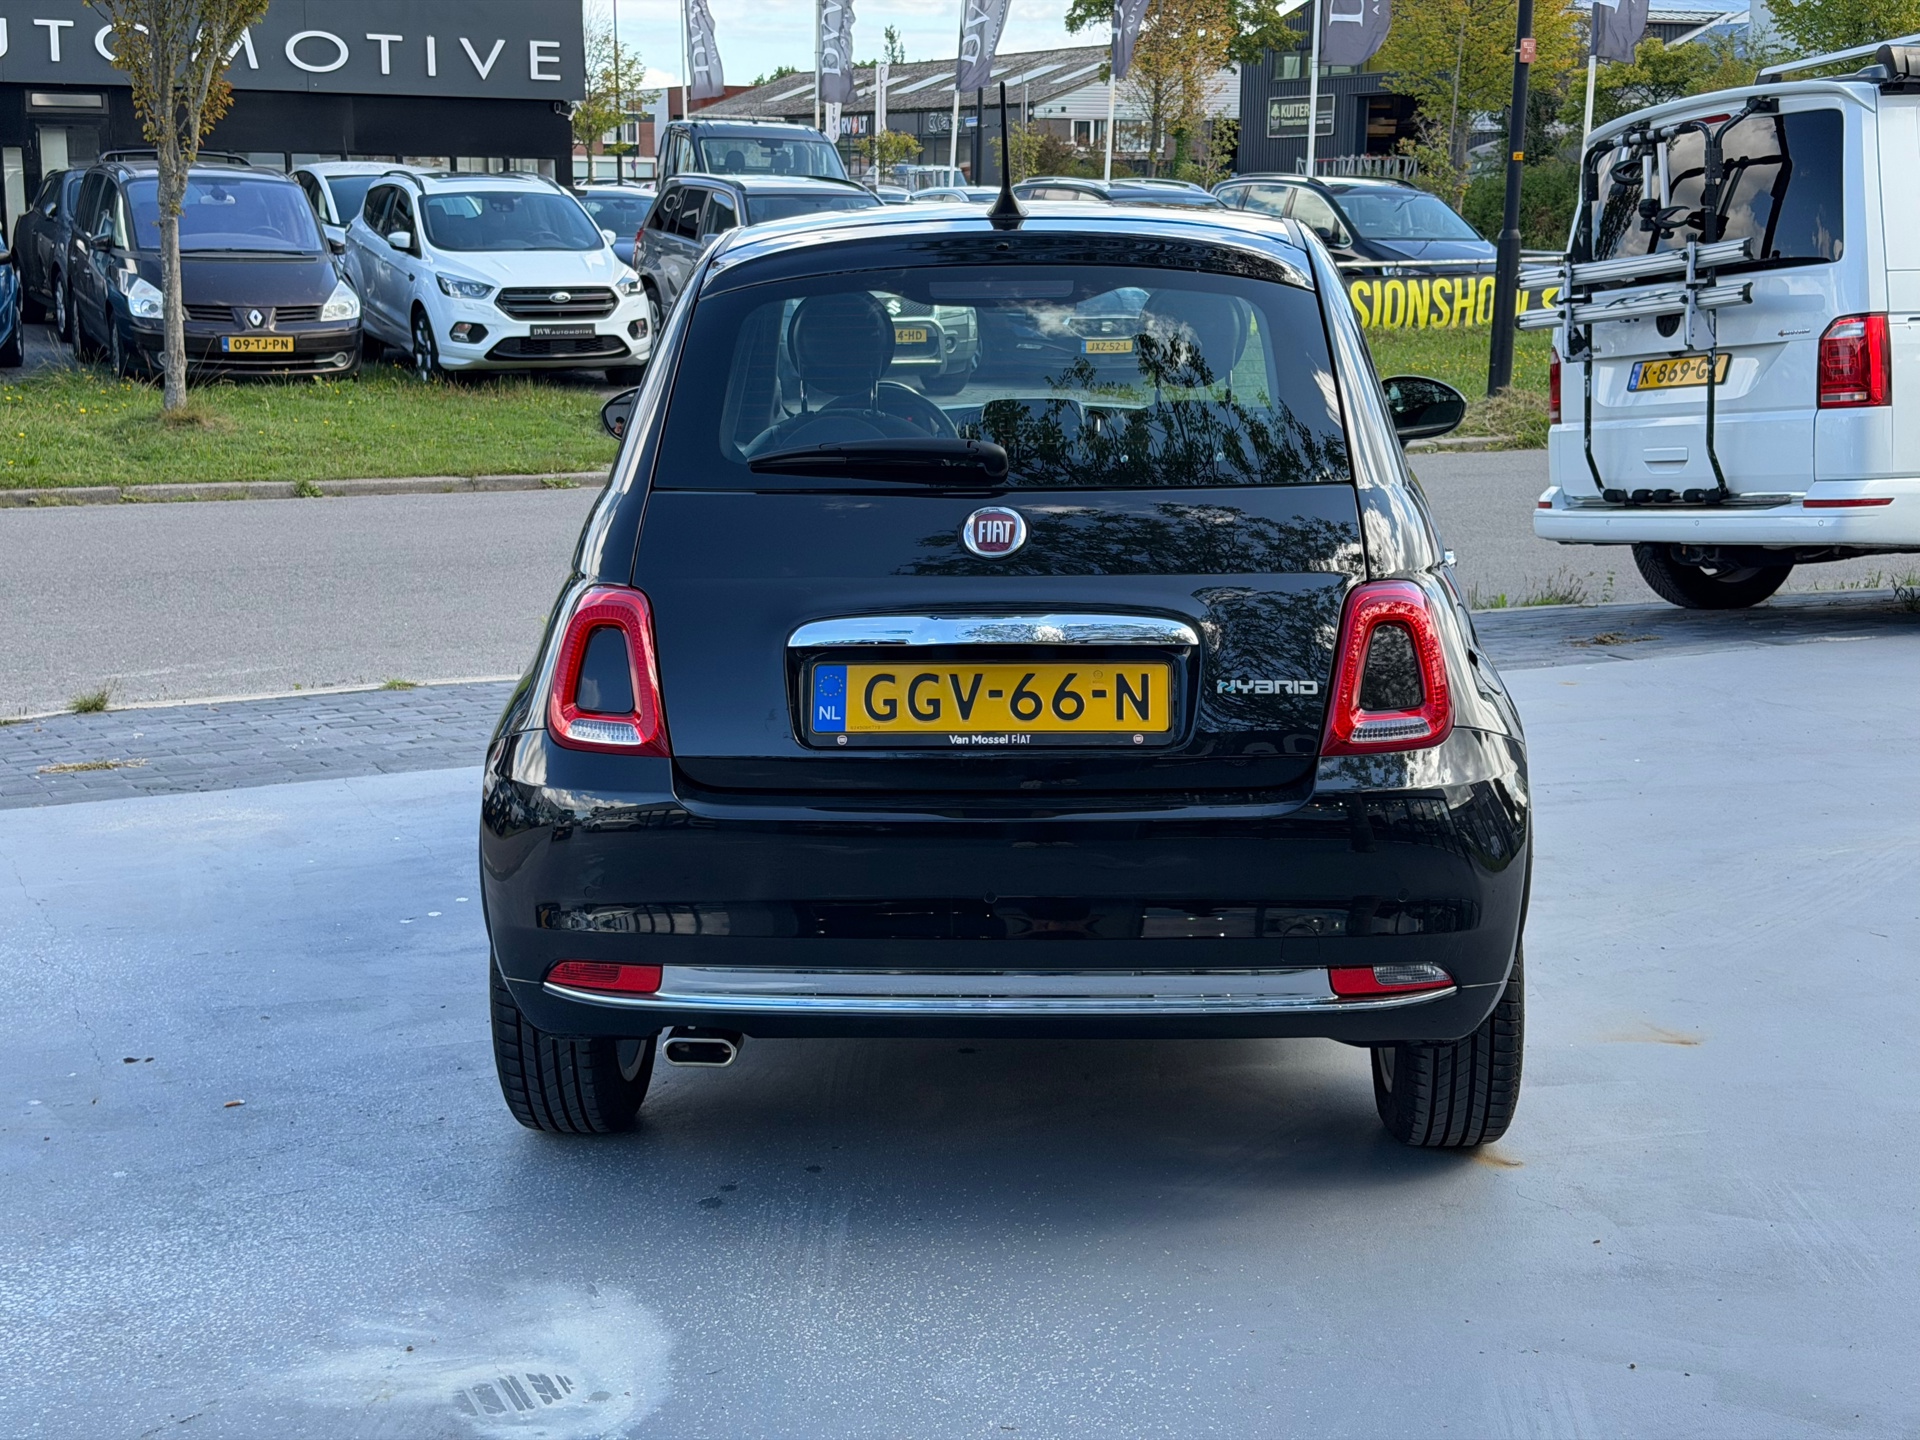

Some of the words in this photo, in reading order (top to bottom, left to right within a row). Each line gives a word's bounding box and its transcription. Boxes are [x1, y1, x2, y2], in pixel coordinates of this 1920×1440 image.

[233, 338, 289, 350] 09-TJ-PN
[1090, 341, 1129, 351] JXZ-52-L
[978, 520, 1014, 543] FIAT
[1217, 680, 1319, 695] HYBRID
[818, 706, 841, 720] NL
[864, 673, 1150, 722] GGV-66-N
[949, 735, 969, 744] Van
[972, 734, 1009, 744] Mossel
[1012, 733, 1031, 744] FIAT
